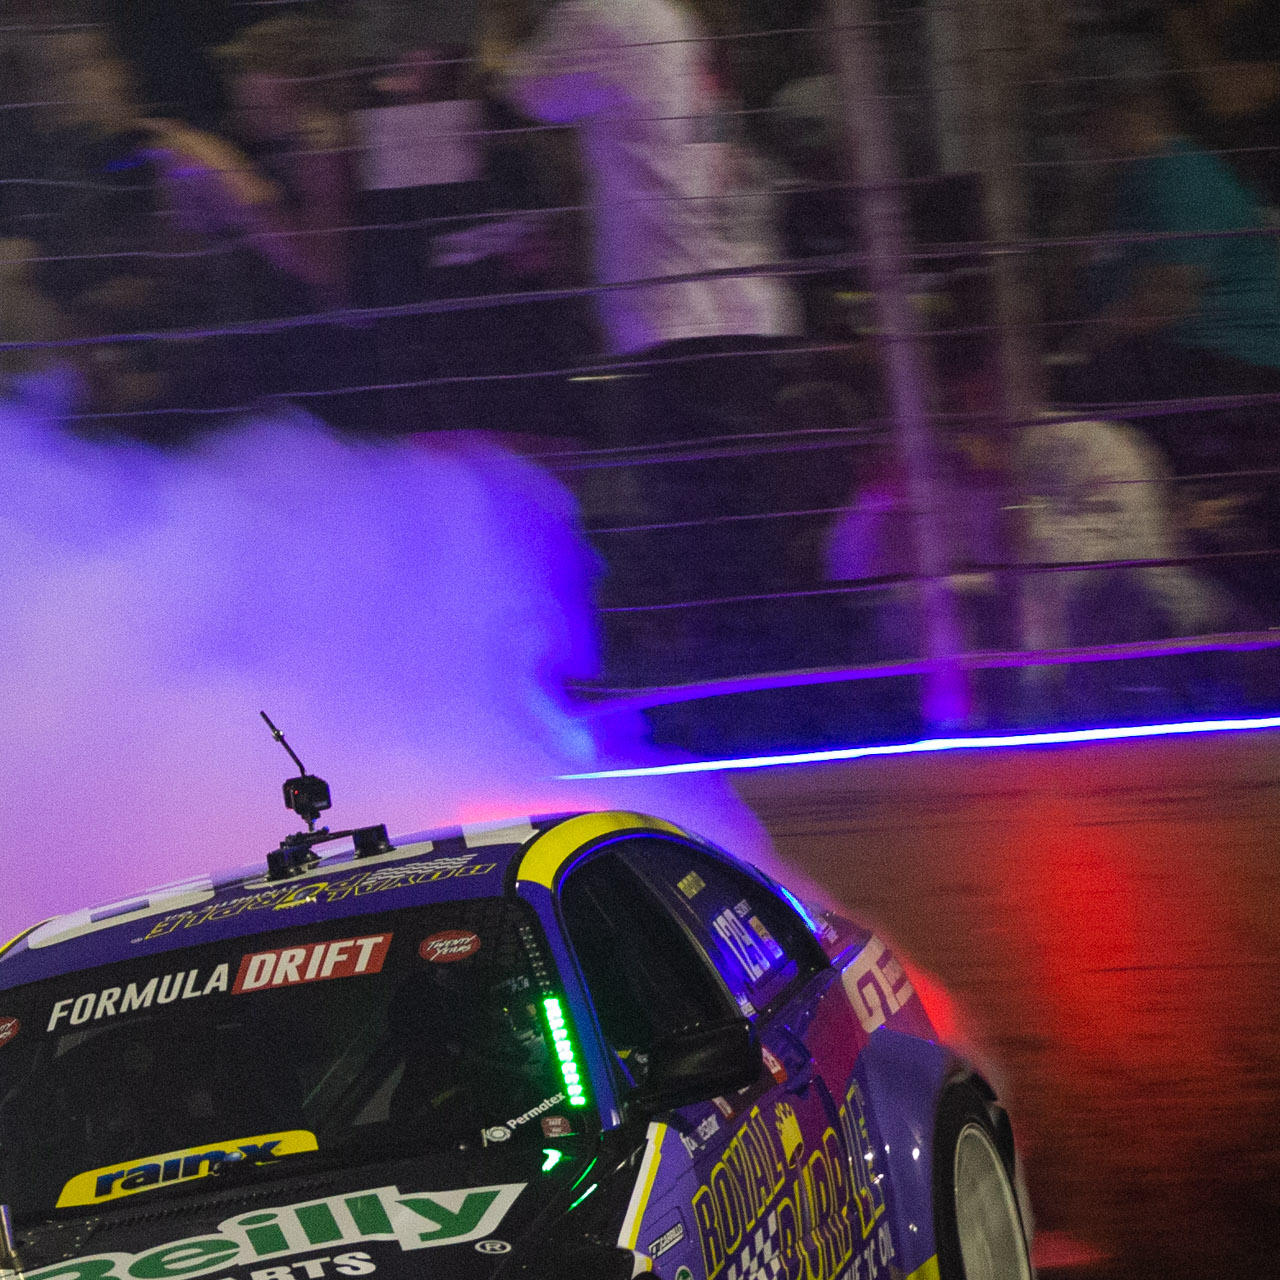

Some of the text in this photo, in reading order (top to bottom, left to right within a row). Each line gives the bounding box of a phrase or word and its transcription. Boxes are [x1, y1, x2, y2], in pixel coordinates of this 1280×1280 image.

[46, 936, 385, 1033] FORMULA DRIFT
[506, 1092, 565, 1130] Permatex
